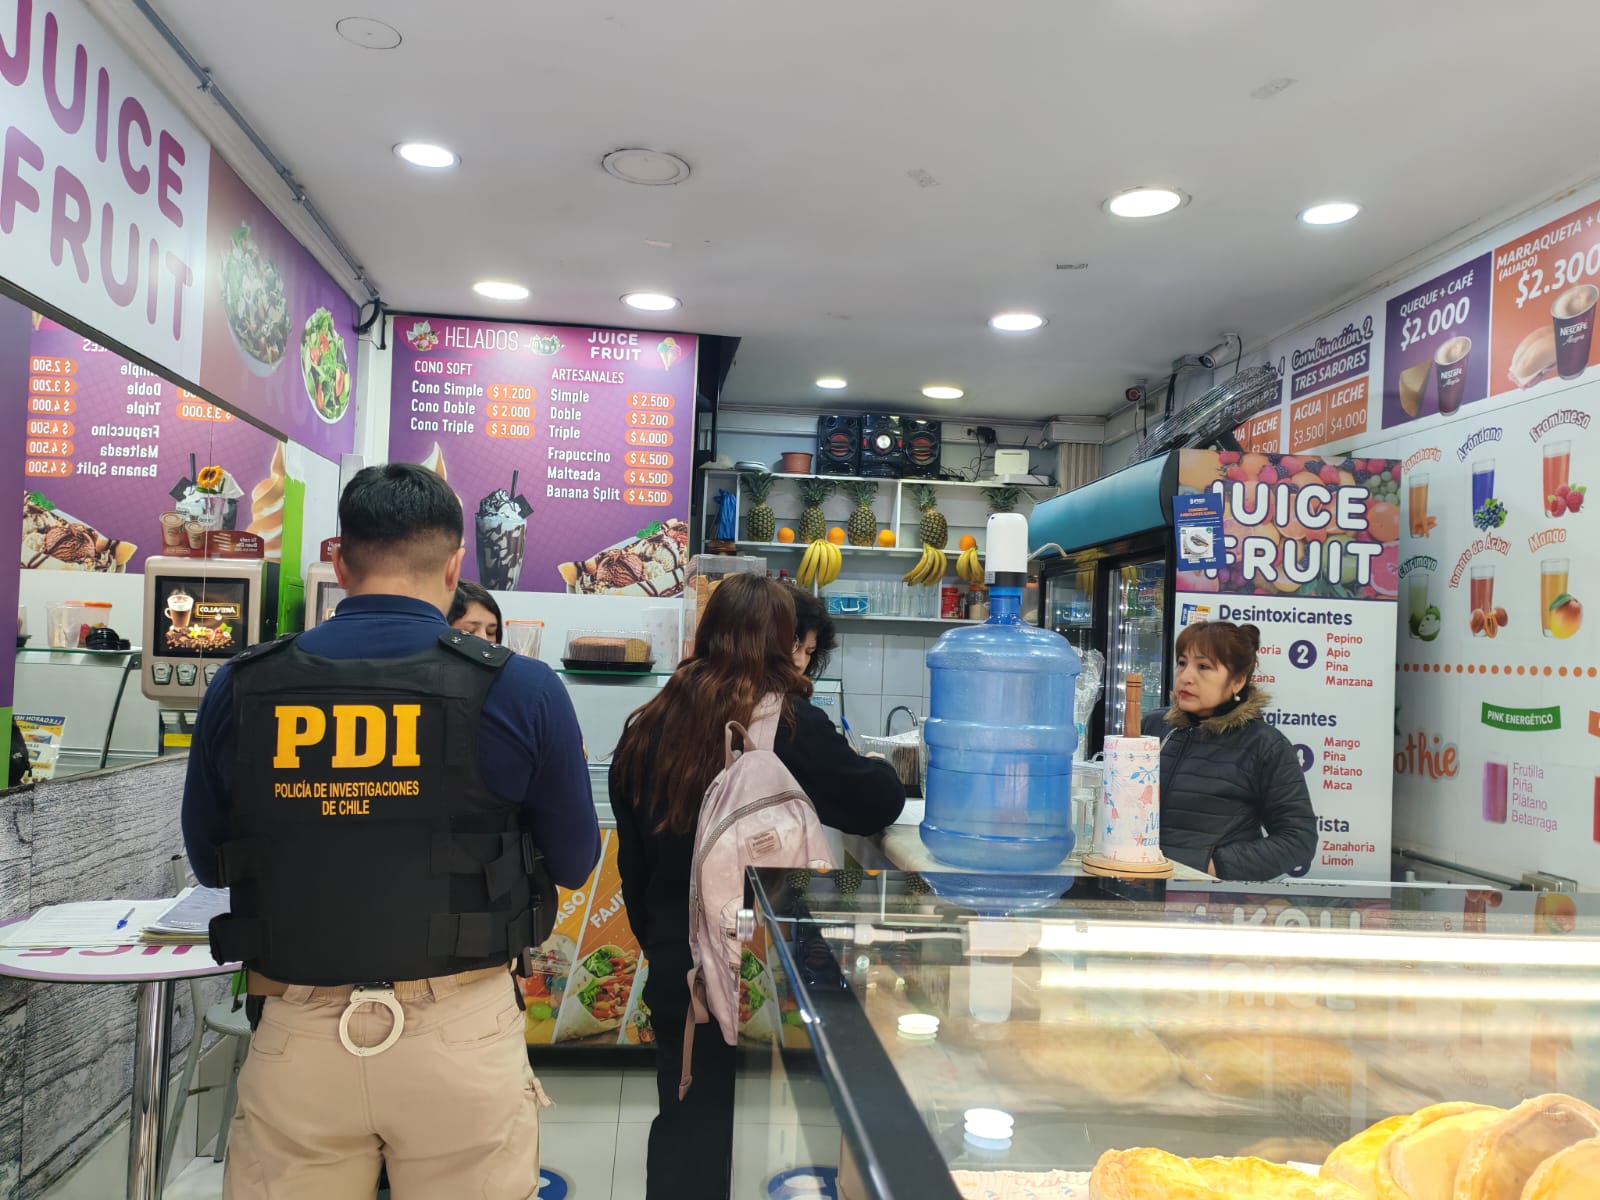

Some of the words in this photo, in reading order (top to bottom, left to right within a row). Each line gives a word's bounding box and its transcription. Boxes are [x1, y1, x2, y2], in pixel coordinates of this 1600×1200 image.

[0, 0, 186, 228] JUICE
[0, 126, 193, 341] FRUIT
[1496, 219, 1582, 270] MARRAQUETA
[1498, 253, 1538, 282] (ALIADO)
[1515, 242, 1600, 309] $2.300
[1400, 289, 1439, 317] QUEQUE
[1446, 269, 1475, 296] CAFÉ
[1401, 296, 1471, 352] $2.000
[445, 326, 519, 351] HELADOS
[587, 331, 639, 346] JUICE
[1292, 323, 1362, 371] Combinación
[1363, 315, 1374, 340] 2
[590, 346, 642, 361] FRUIT
[414, 360, 443, 374] CONO
[446, 361, 473, 376] SOFT
[551, 367, 625, 384] ARTESANALES
[1295, 371, 1318, 392] TRES
[1318, 350, 1367, 383] SABORES
[411, 380, 440, 395] Cono
[443, 383, 484, 399] Simple
[551, 388, 590, 403] Simple
[411, 398, 439, 413] Cono
[443, 401, 476, 416] Doble
[1293, 401, 1322, 422] AGUA
[1331, 383, 1366, 409] LECHE
[550, 407, 582, 421] Doble
[410, 417, 439, 432] Cono
[442, 419, 475, 434] Triple
[549, 425, 581, 440] Triple
[1252, 416, 1278, 437] LECHE
[1293, 423, 1325, 447] $3.500
[1330, 409, 1367, 436] $4.000
[1456, 426, 1503, 463] Arándano
[548, 447, 611, 464] Frapuccino
[547, 466, 601, 481] Malteada
[547, 485, 590, 500] Banana
[593, 486, 620, 502] Split
[1472, 538, 1484, 552] de
[1485, 531, 1513, 556] Árbol
[1528, 528, 1567, 553] Mango
[1218, 604, 1353, 626] Desintoxicantes
[1326, 632, 1363, 645] Pepino
[1297, 645, 1309, 664] 2
[1326, 647, 1351, 660] Apio
[1326, 675, 1373, 687] Manzana
[1487, 710, 1505, 724] PINK
[1505, 711, 1553, 726] ENERGÉTICO
[273, 704, 421, 769] PDI
[1324, 737, 1361, 750] Mango
[1394, 731, 1458, 780] othie
[1323, 764, 1363, 777] Plátano
[1512, 762, 1544, 779] Frutilla
[274, 779, 312, 798] POLICÍA
[314, 783, 327, 798] DE
[329, 780, 420, 798] INVESTIGACIONES
[1323, 779, 1353, 791] Maca
[1512, 777, 1533, 793] Piña
[322, 800, 336, 816] DE
[338, 799, 370, 815] CHILE
[1511, 793, 1547, 810] Plátano
[1316, 816, 1350, 833] ista
[1511, 809, 1558, 832] Betarraga
[1322, 841, 1375, 853] Zanahoria
[1321, 854, 1354, 866] Limón
[553, 891, 586, 930] ASO
